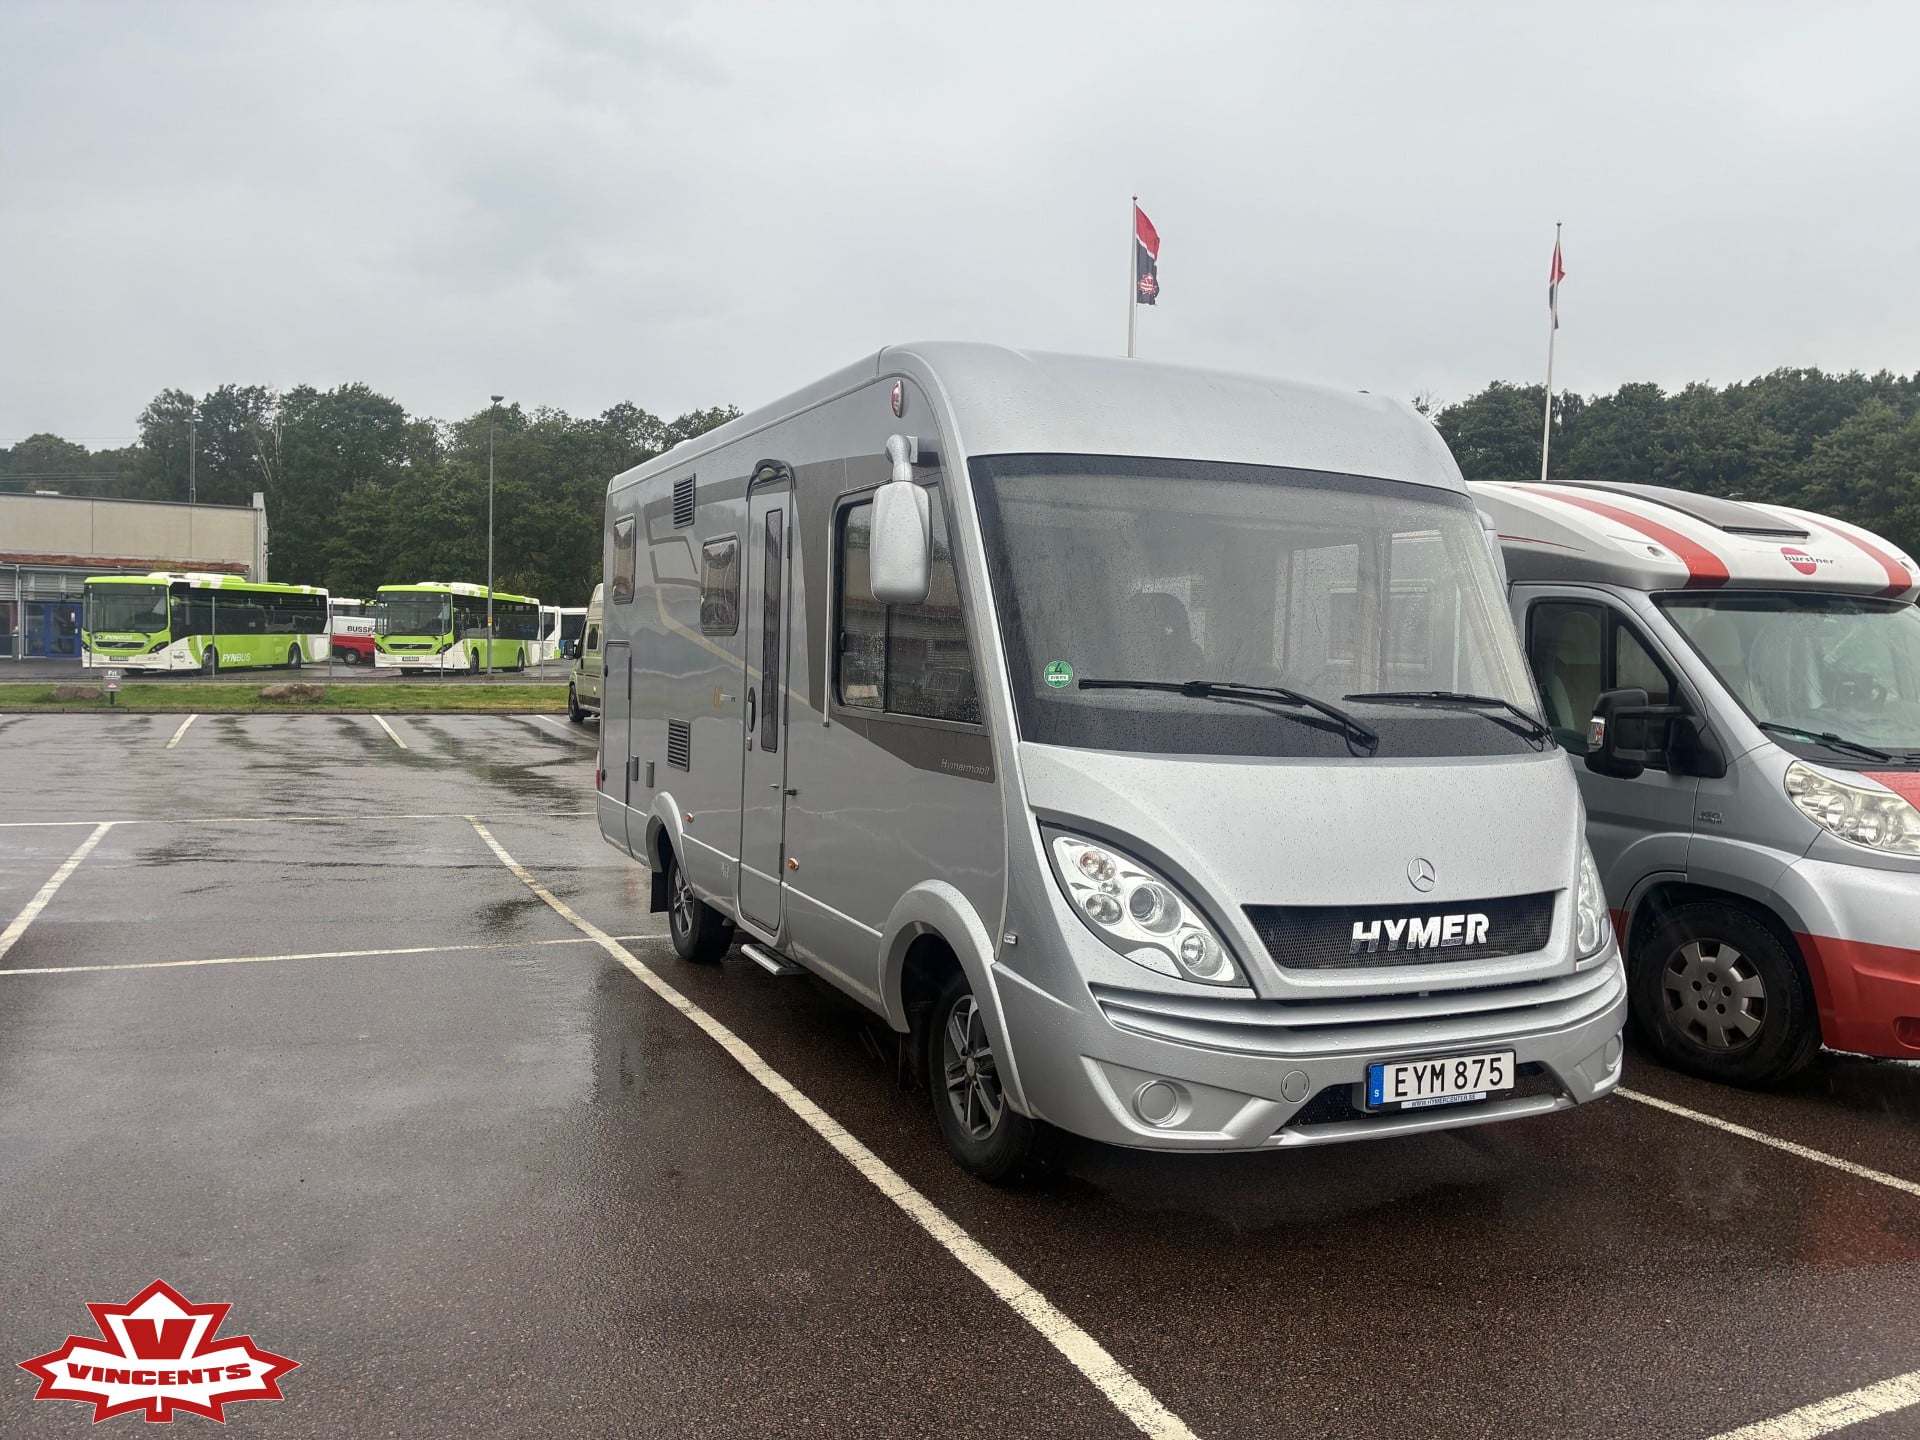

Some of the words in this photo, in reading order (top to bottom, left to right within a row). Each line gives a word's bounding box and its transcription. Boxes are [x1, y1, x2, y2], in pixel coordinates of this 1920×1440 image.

[222, 653, 251, 662] FYNBUS
[1054, 662, 1063, 673] 4
[941, 759, 990, 775] Hymermobil
[1350, 913, 1489, 953] HYMER
[1394, 1062, 1445, 1098] EYM
[1454, 1056, 1504, 1090] 875
[1373, 1088, 1380, 1098] S
